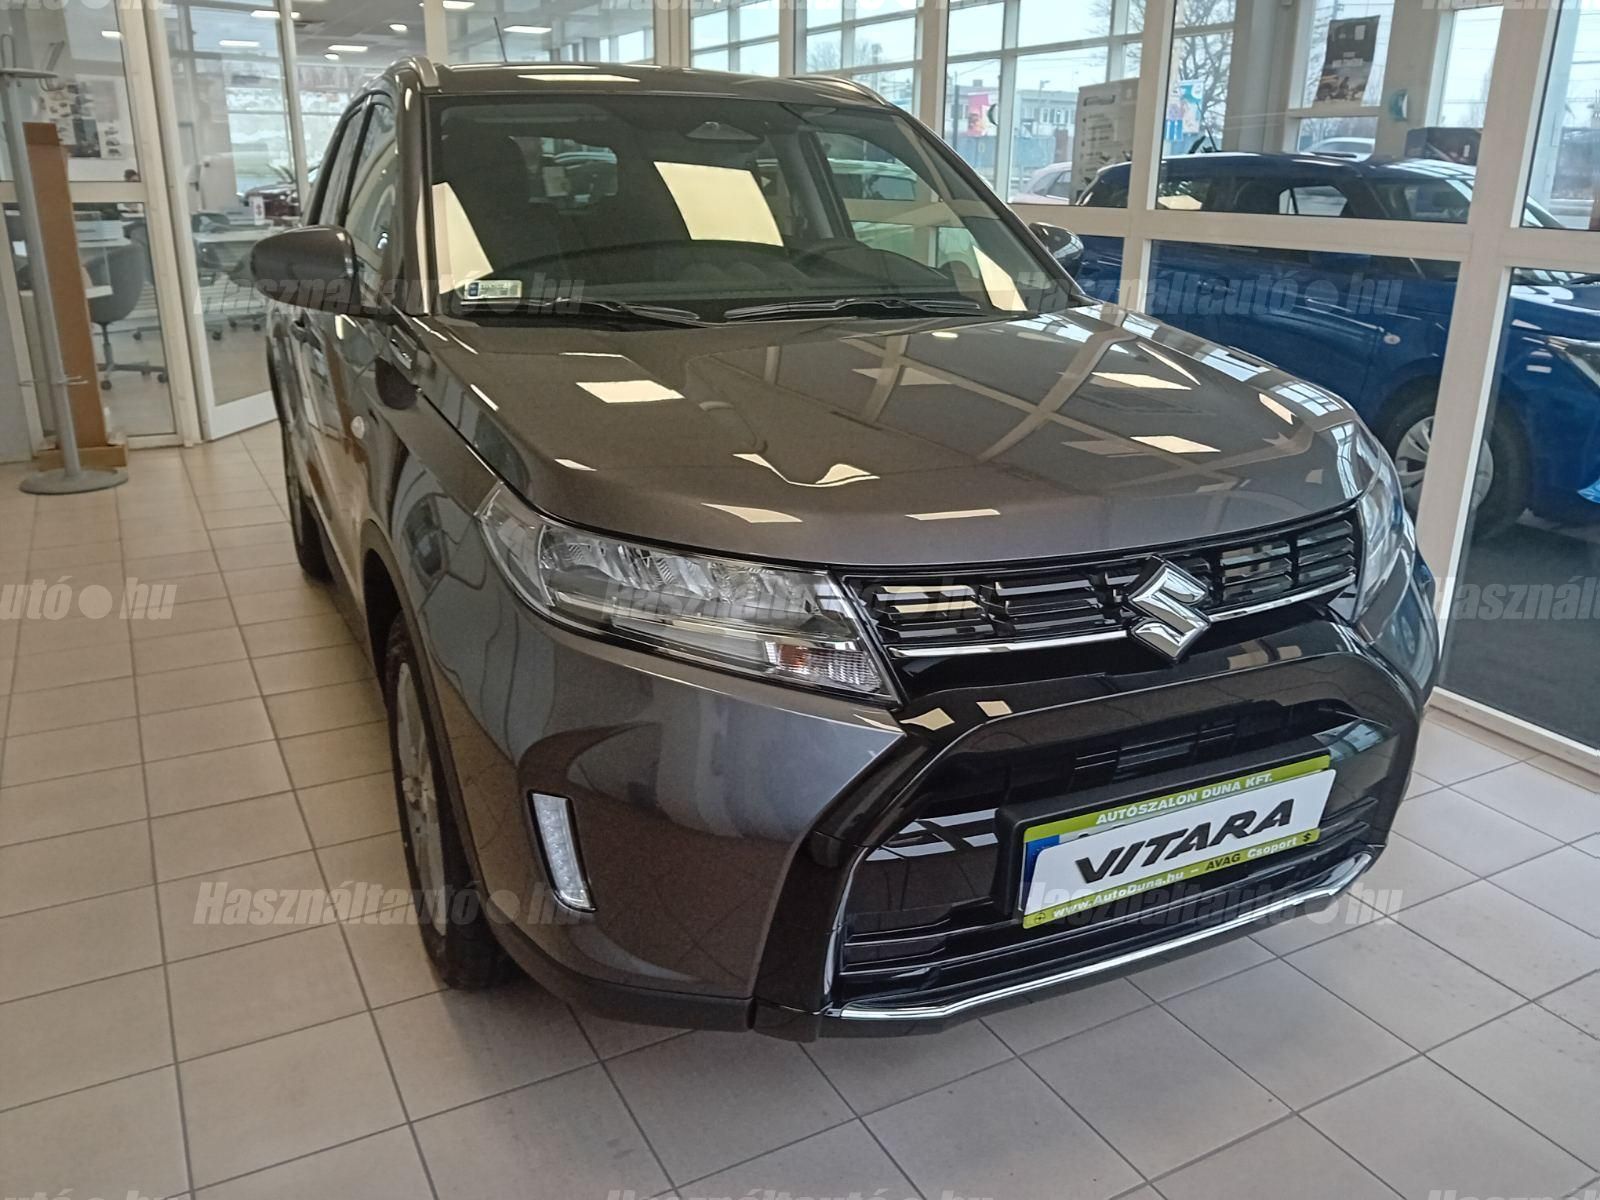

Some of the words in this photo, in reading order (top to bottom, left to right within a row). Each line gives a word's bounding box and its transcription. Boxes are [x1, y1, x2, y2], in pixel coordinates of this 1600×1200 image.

[1095, 792, 1197, 825] AUTÓSZALON
[1201, 781, 1241, 799] DUNA
[1245, 773, 1273, 788] KFT.
[1053, 871, 1185, 919] www.AutoDuna.hu
[1205, 853, 1241, 871] AVAG
[1247, 837, 1297, 859] Csoport
[1075, 798, 1294, 884] VITARA
